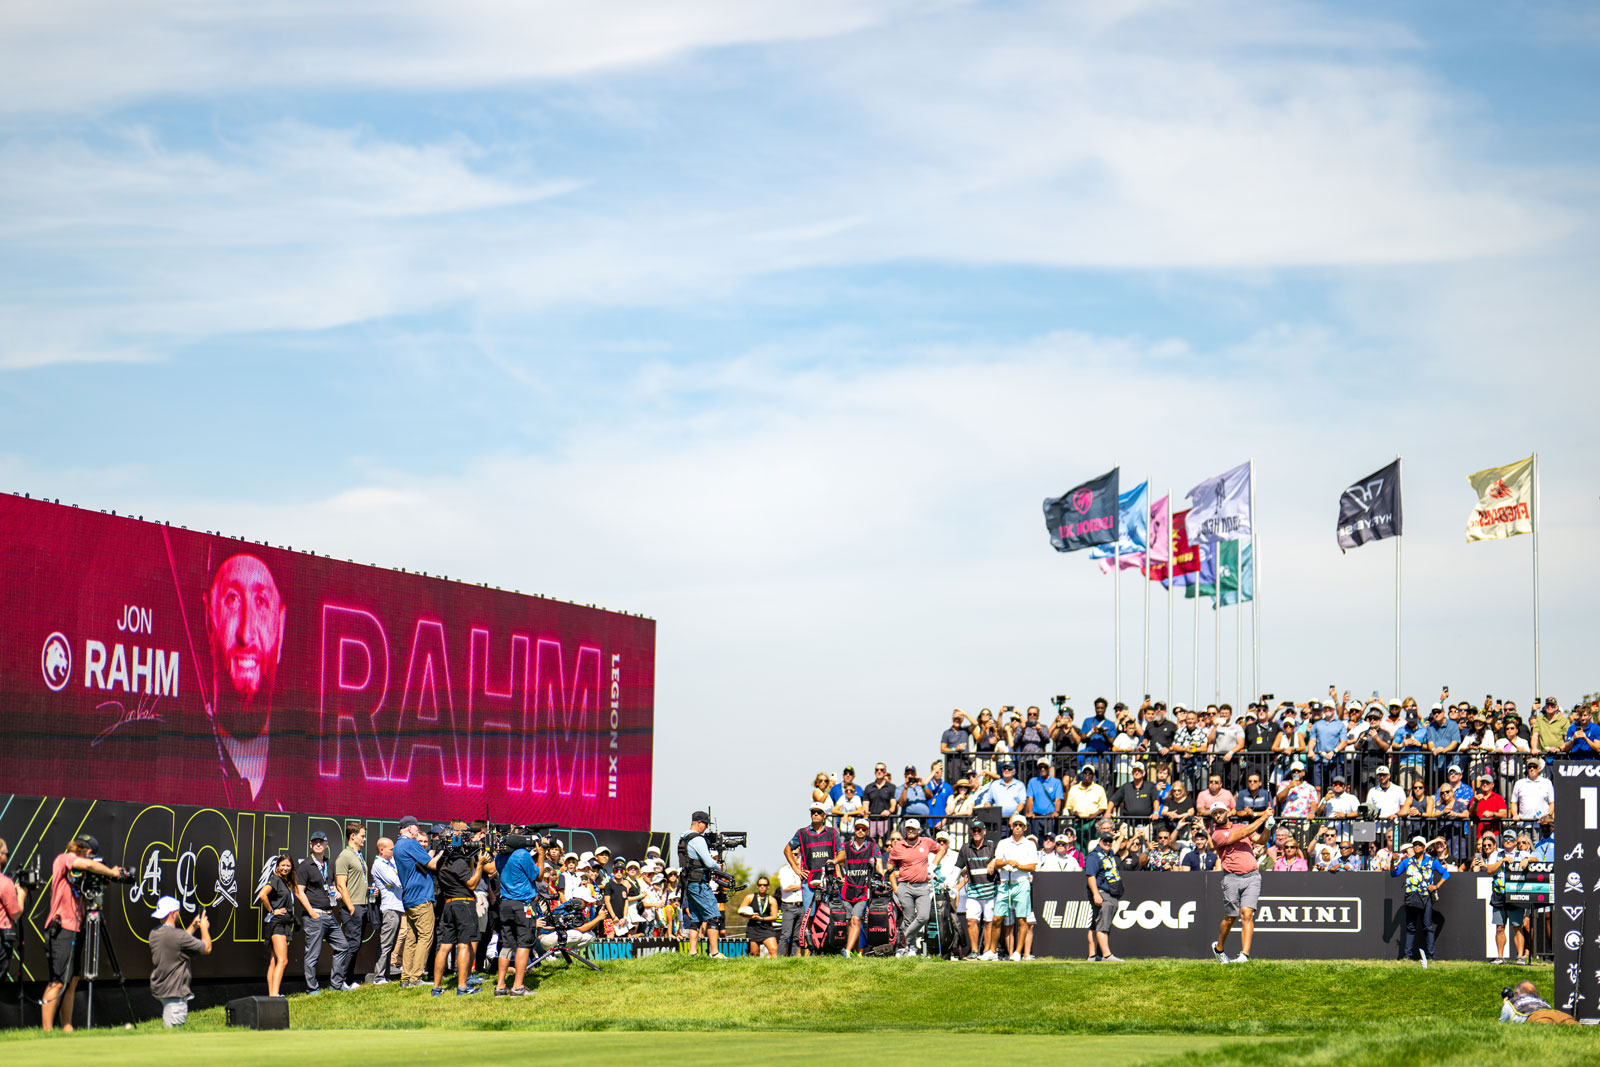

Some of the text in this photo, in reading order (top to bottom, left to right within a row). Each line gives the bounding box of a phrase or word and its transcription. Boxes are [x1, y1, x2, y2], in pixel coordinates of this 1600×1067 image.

[117, 605, 152, 634] JON
[85, 639, 179, 697] RAHM
[319, 604, 601, 797] RAHM
[608, 653, 620, 798] LEGION XIII
[812, 851, 829, 859] RAHM
[1528, 863, 1553, 872] GOLF
[1112, 900, 1197, 929] GOLF
[1240, 905, 1351, 922] ANINI
